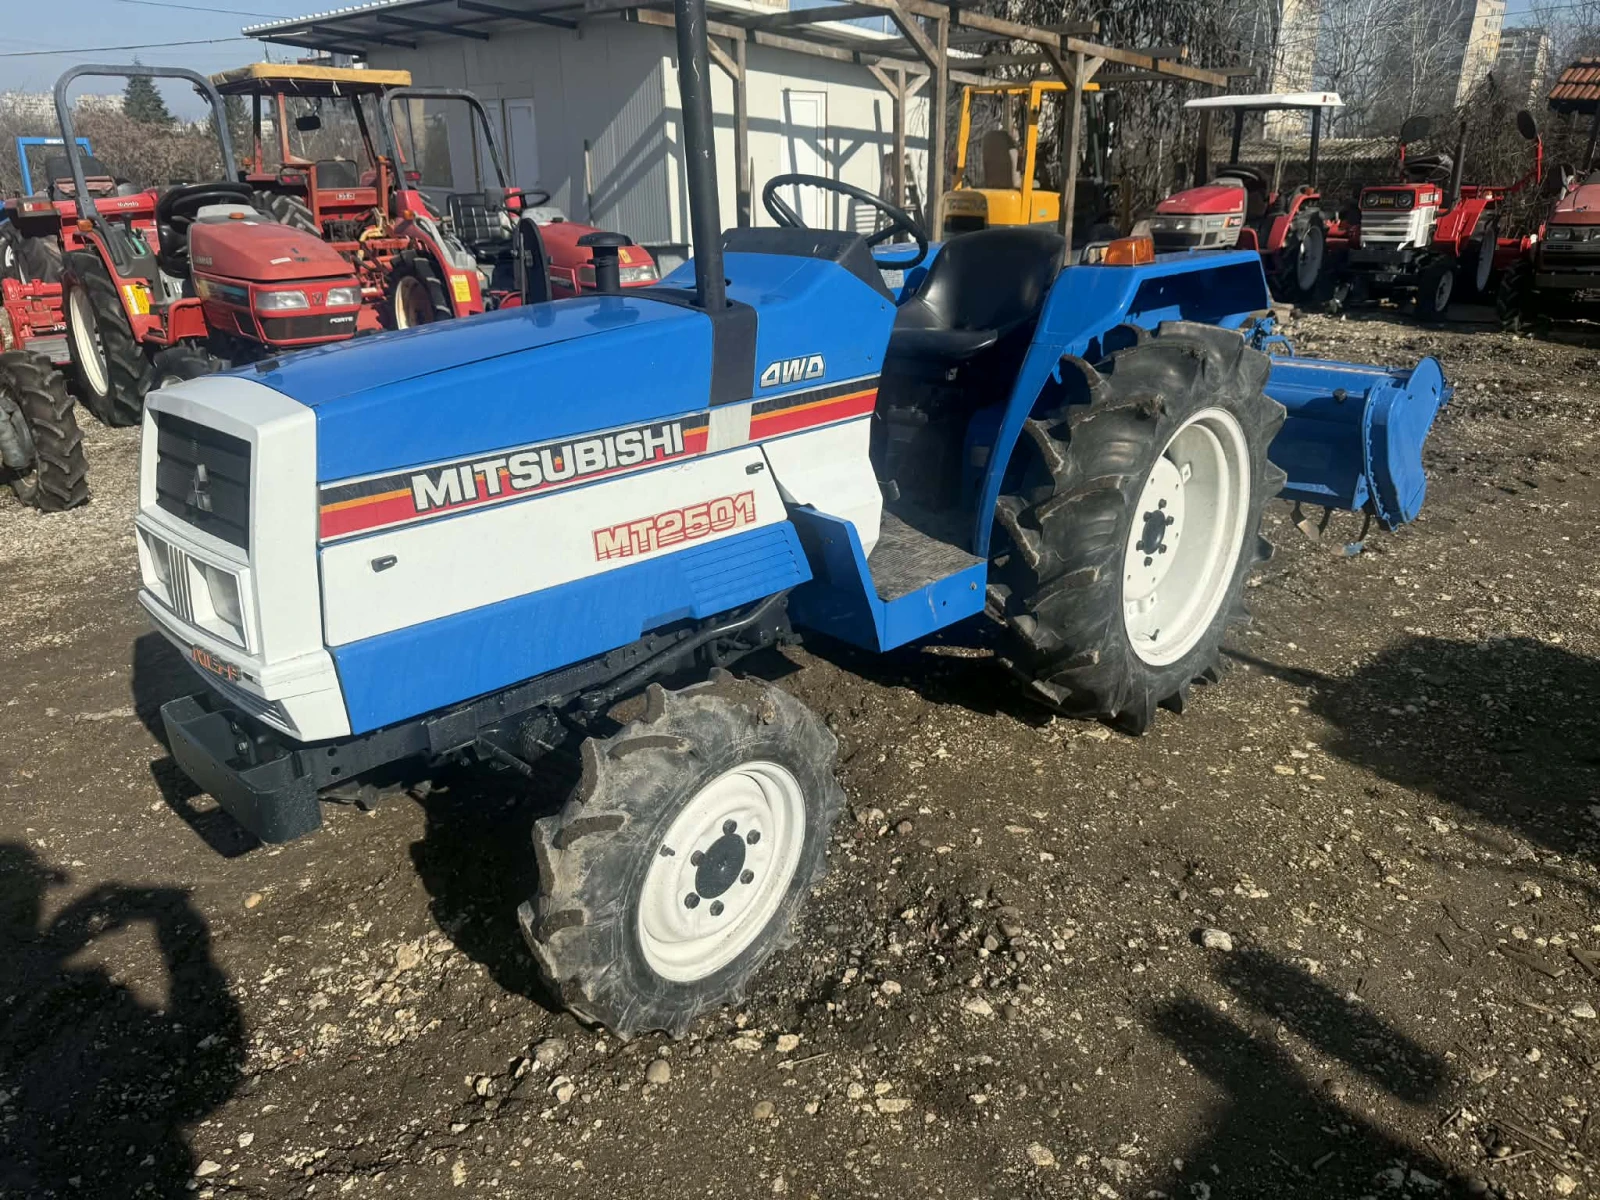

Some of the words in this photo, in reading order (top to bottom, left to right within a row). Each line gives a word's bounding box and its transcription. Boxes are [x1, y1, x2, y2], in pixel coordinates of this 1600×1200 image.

[760, 354, 825, 388] 4WD
[411, 422, 685, 513] MITSUBISHI
[593, 490, 757, 561] MT2501
